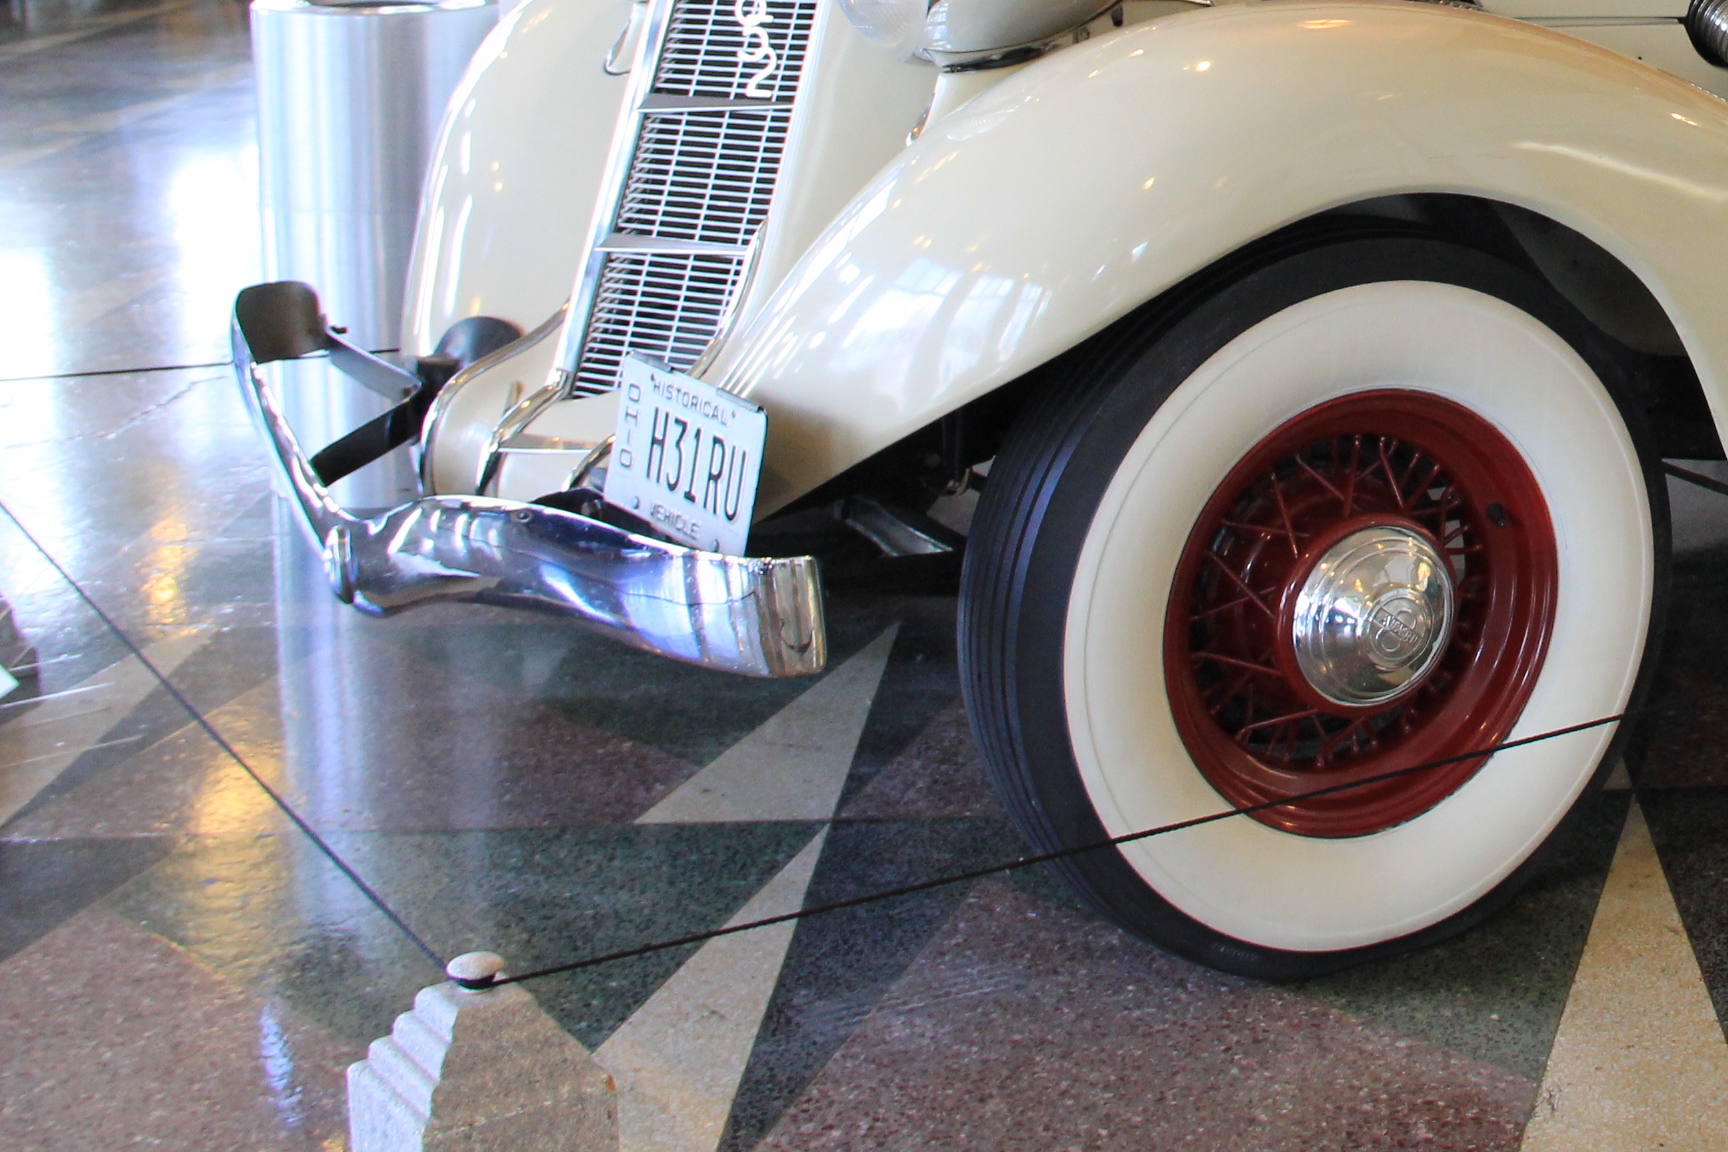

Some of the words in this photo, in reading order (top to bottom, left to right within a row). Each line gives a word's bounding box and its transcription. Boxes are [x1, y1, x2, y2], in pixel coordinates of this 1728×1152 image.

[618, 382, 642, 470] OHIO
[653, 377, 730, 427] HISTORICAL
[646, 405, 748, 523] H31RU
